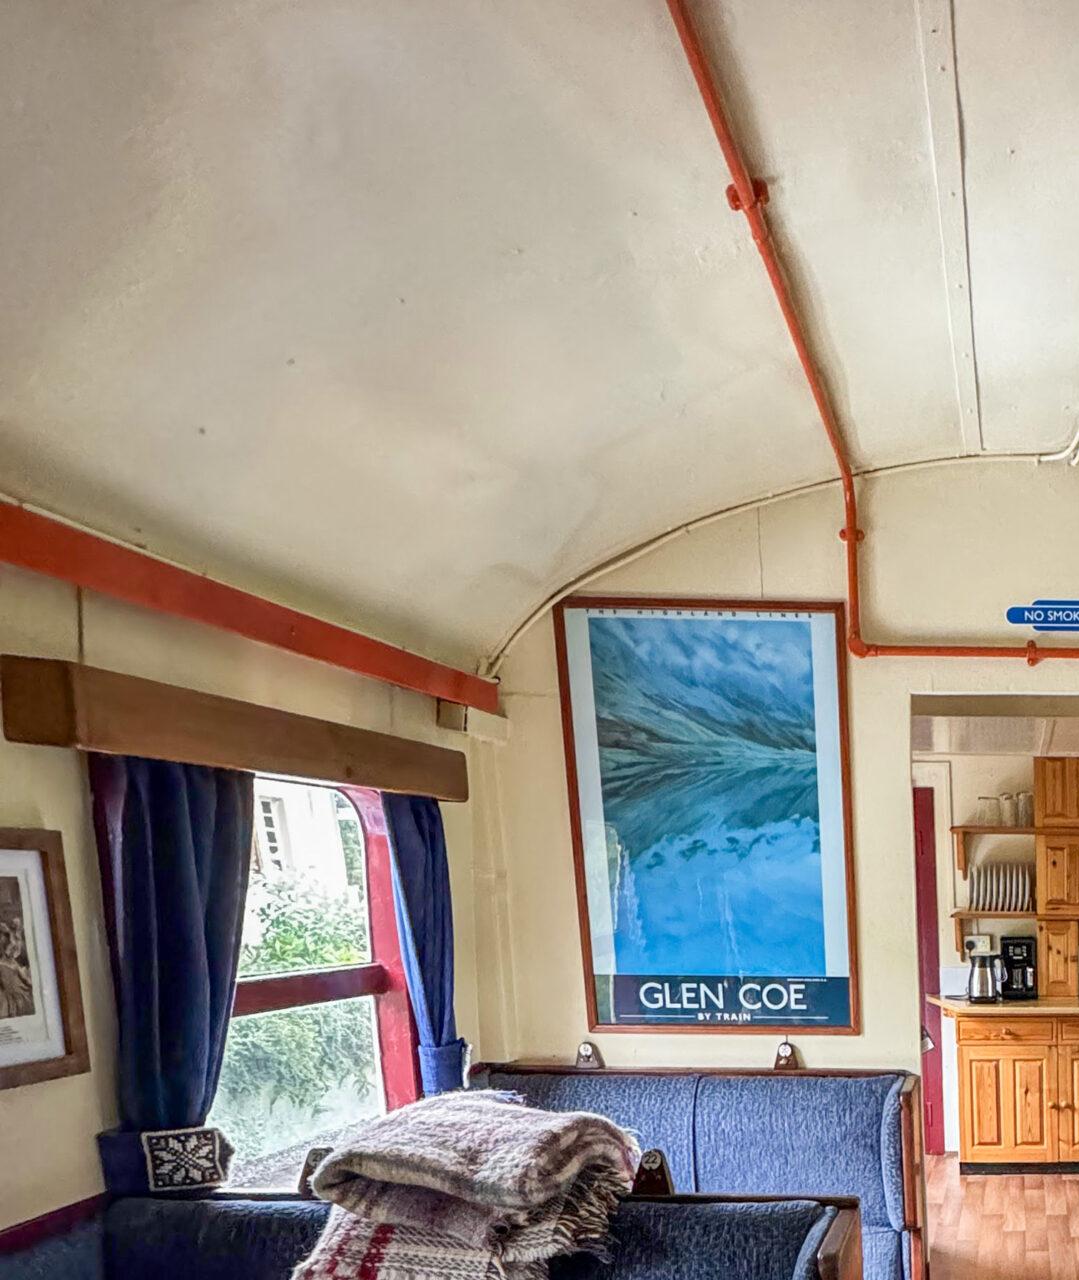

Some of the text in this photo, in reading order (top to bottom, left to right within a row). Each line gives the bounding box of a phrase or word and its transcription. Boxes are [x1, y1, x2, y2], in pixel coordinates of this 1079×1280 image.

[1024, 610, 1044, 621] NO
[639, 982, 808, 1011] GLEN COE
[697, 1012, 751, 1021] BY TRAIN
[644, 1154, 657, 1164] 22
